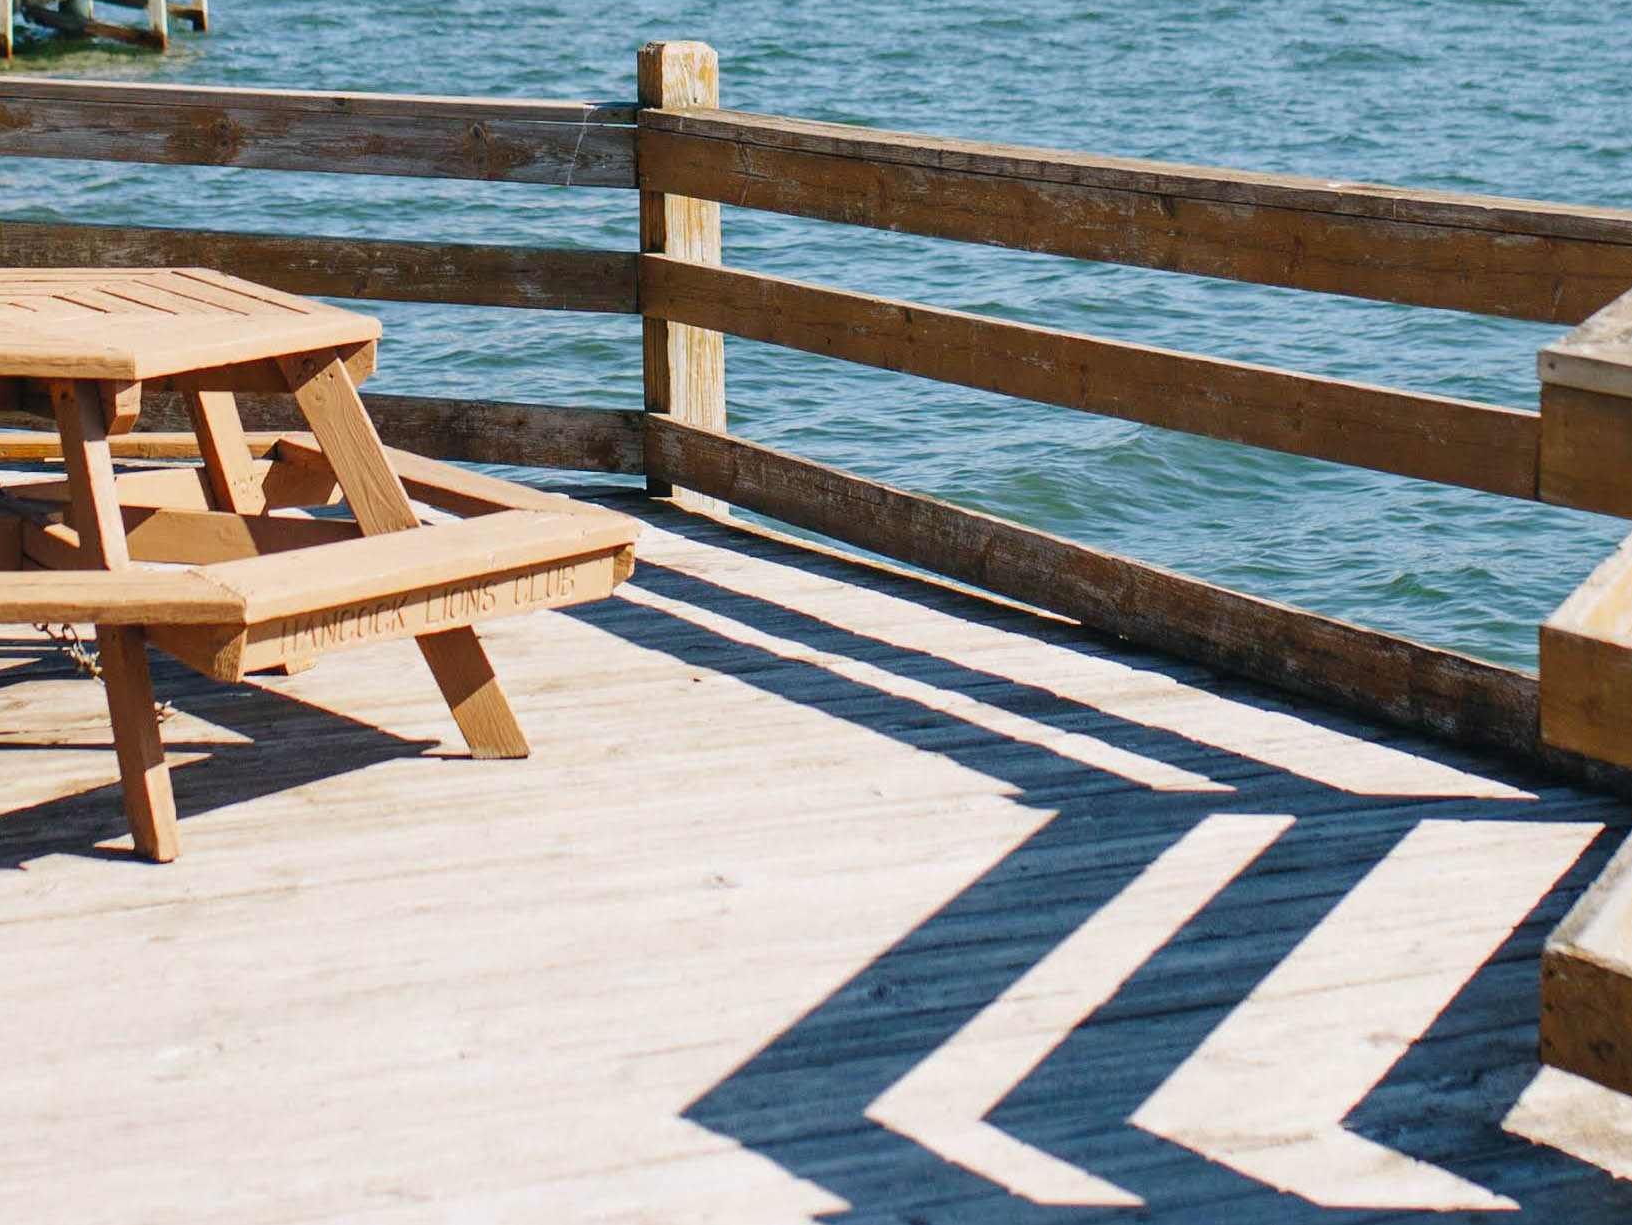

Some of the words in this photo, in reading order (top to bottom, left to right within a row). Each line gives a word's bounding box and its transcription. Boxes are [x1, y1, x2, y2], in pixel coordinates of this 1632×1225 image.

[280, 594, 406, 654] HANCOCK
[424, 580, 497, 625] LIONS
[514, 565, 576, 606] CLUB
